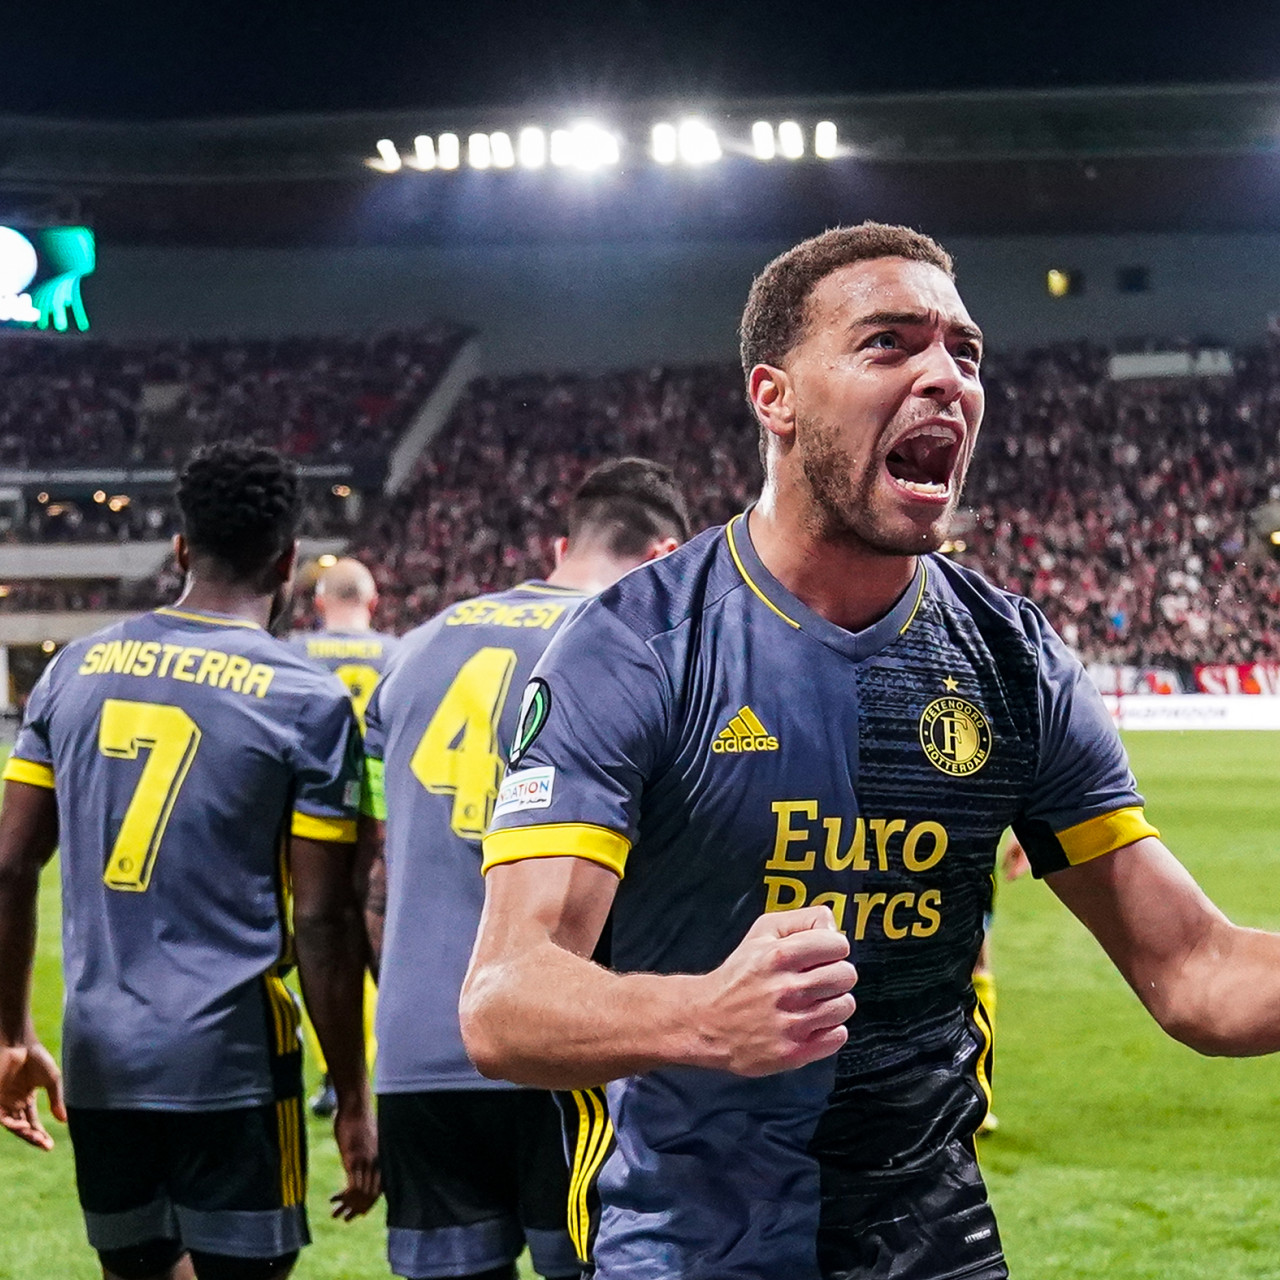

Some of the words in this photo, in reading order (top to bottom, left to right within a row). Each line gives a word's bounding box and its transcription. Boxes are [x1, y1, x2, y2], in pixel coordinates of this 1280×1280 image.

[446, 601, 569, 629] SENESI
[78, 640, 275, 698] SINISTERRA
[925, 701, 984, 728] FEYENOORD
[409, 646, 517, 840] 4
[712, 736, 780, 753] adidas
[926, 743, 986, 773] ROTTERDAM
[99, 698, 202, 893] 7
[765, 799, 948, 872] Euro
